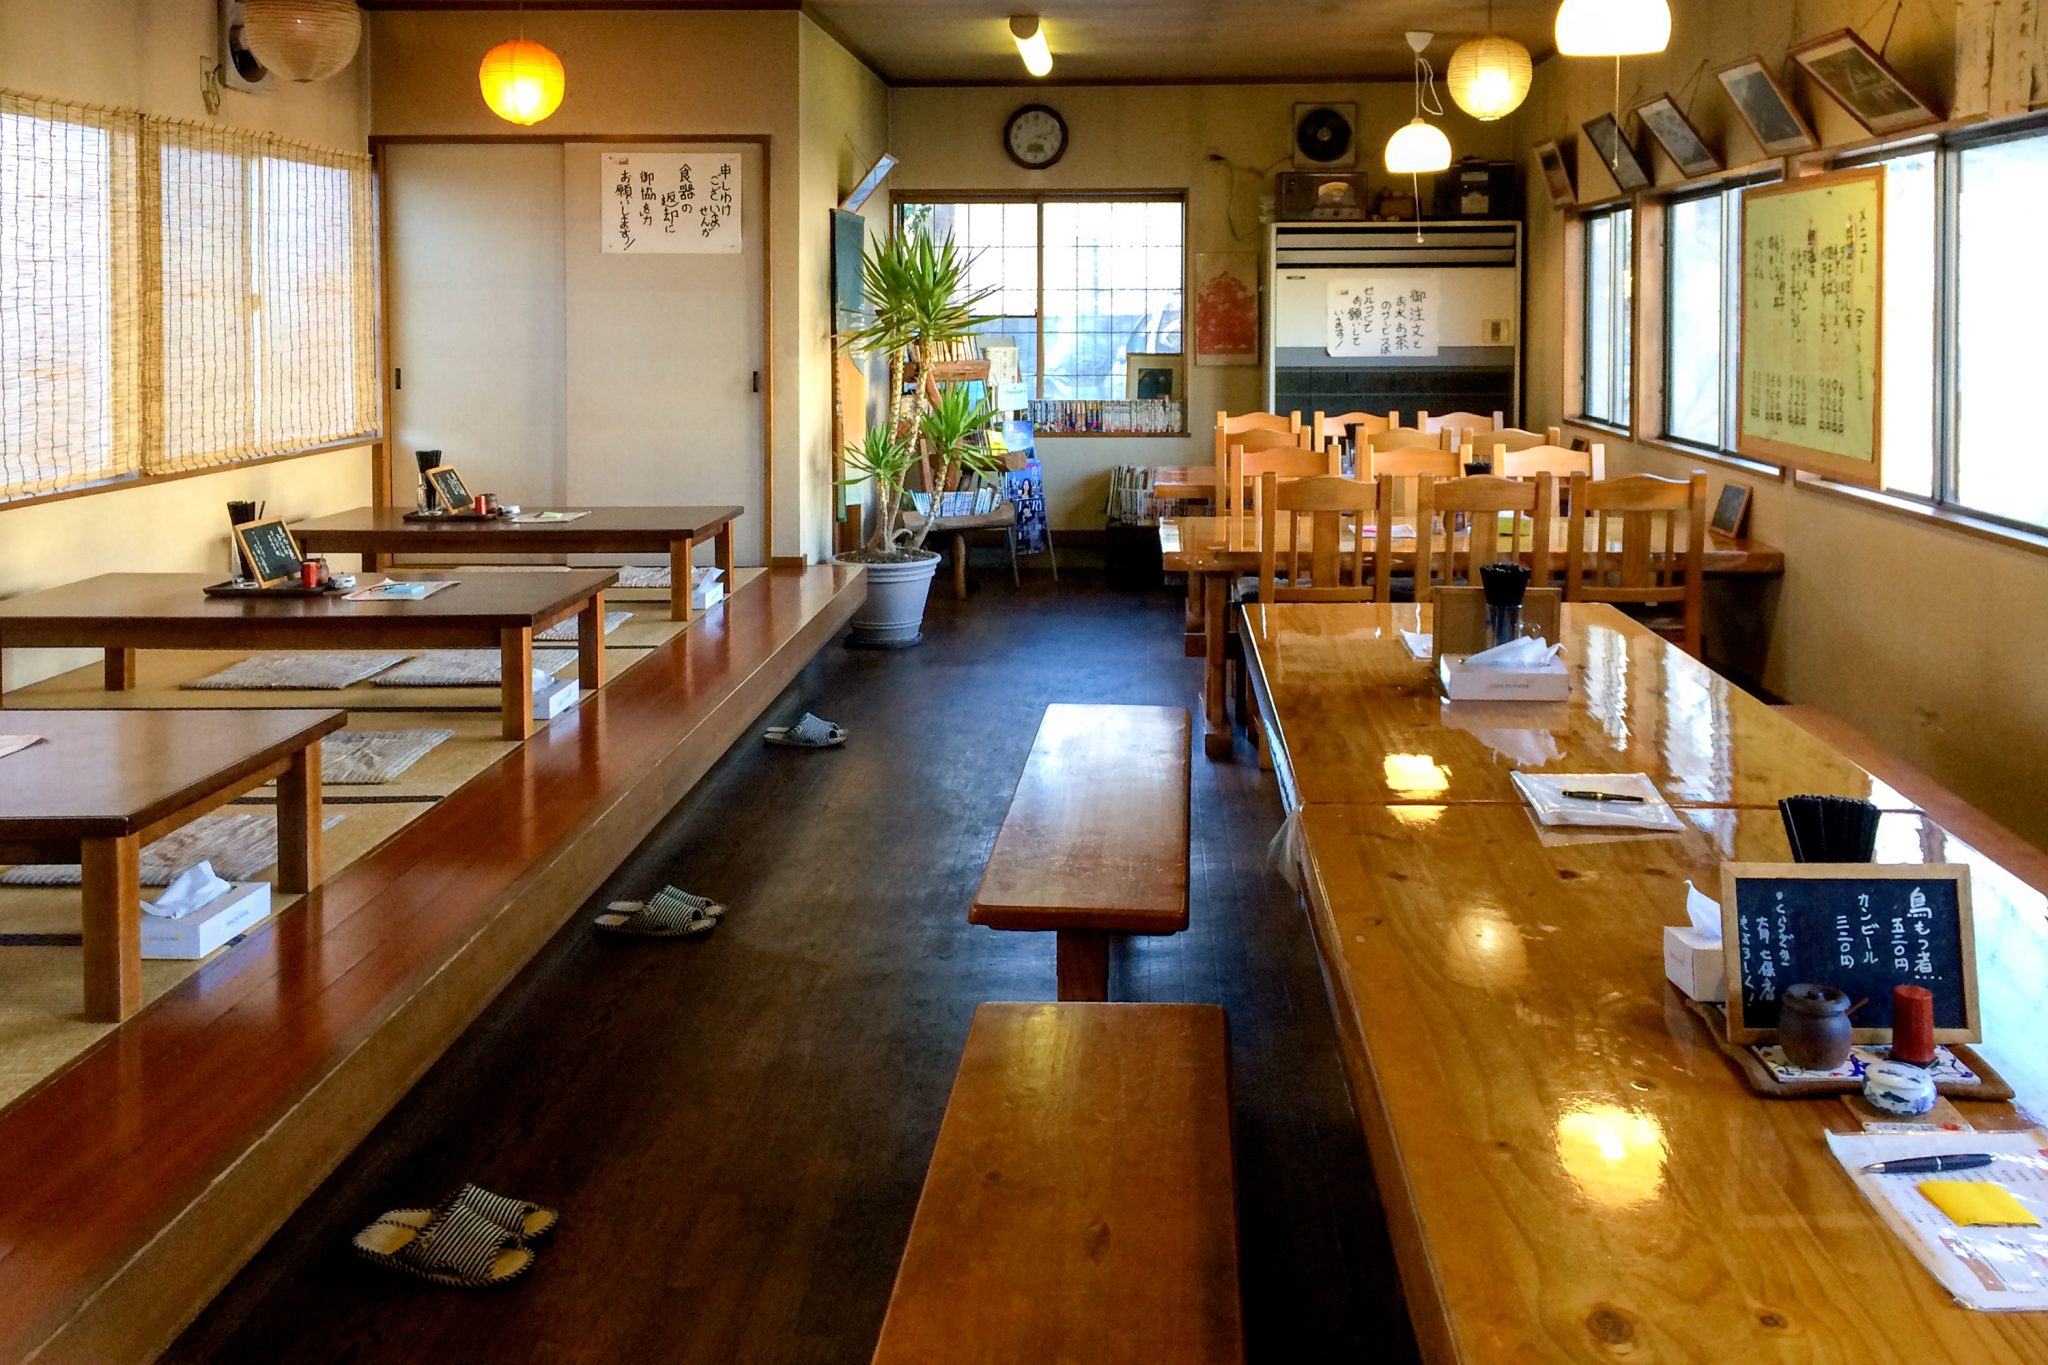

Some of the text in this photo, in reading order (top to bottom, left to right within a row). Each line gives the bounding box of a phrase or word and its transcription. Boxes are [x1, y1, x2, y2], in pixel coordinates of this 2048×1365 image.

[661, 191, 680, 234] 返却に
[678, 163, 695, 214] 食器の
[720, 163, 732, 217] 申しわけ
[1347, 295, 1363, 346] お願いして
[1395, 295, 1409, 350] お水お茶
[1409, 289, 1426, 349] 御注文と
[1858, 893, 1880, 965] カンビール
[1907, 886, 1943, 980] 鳥もつ煮
